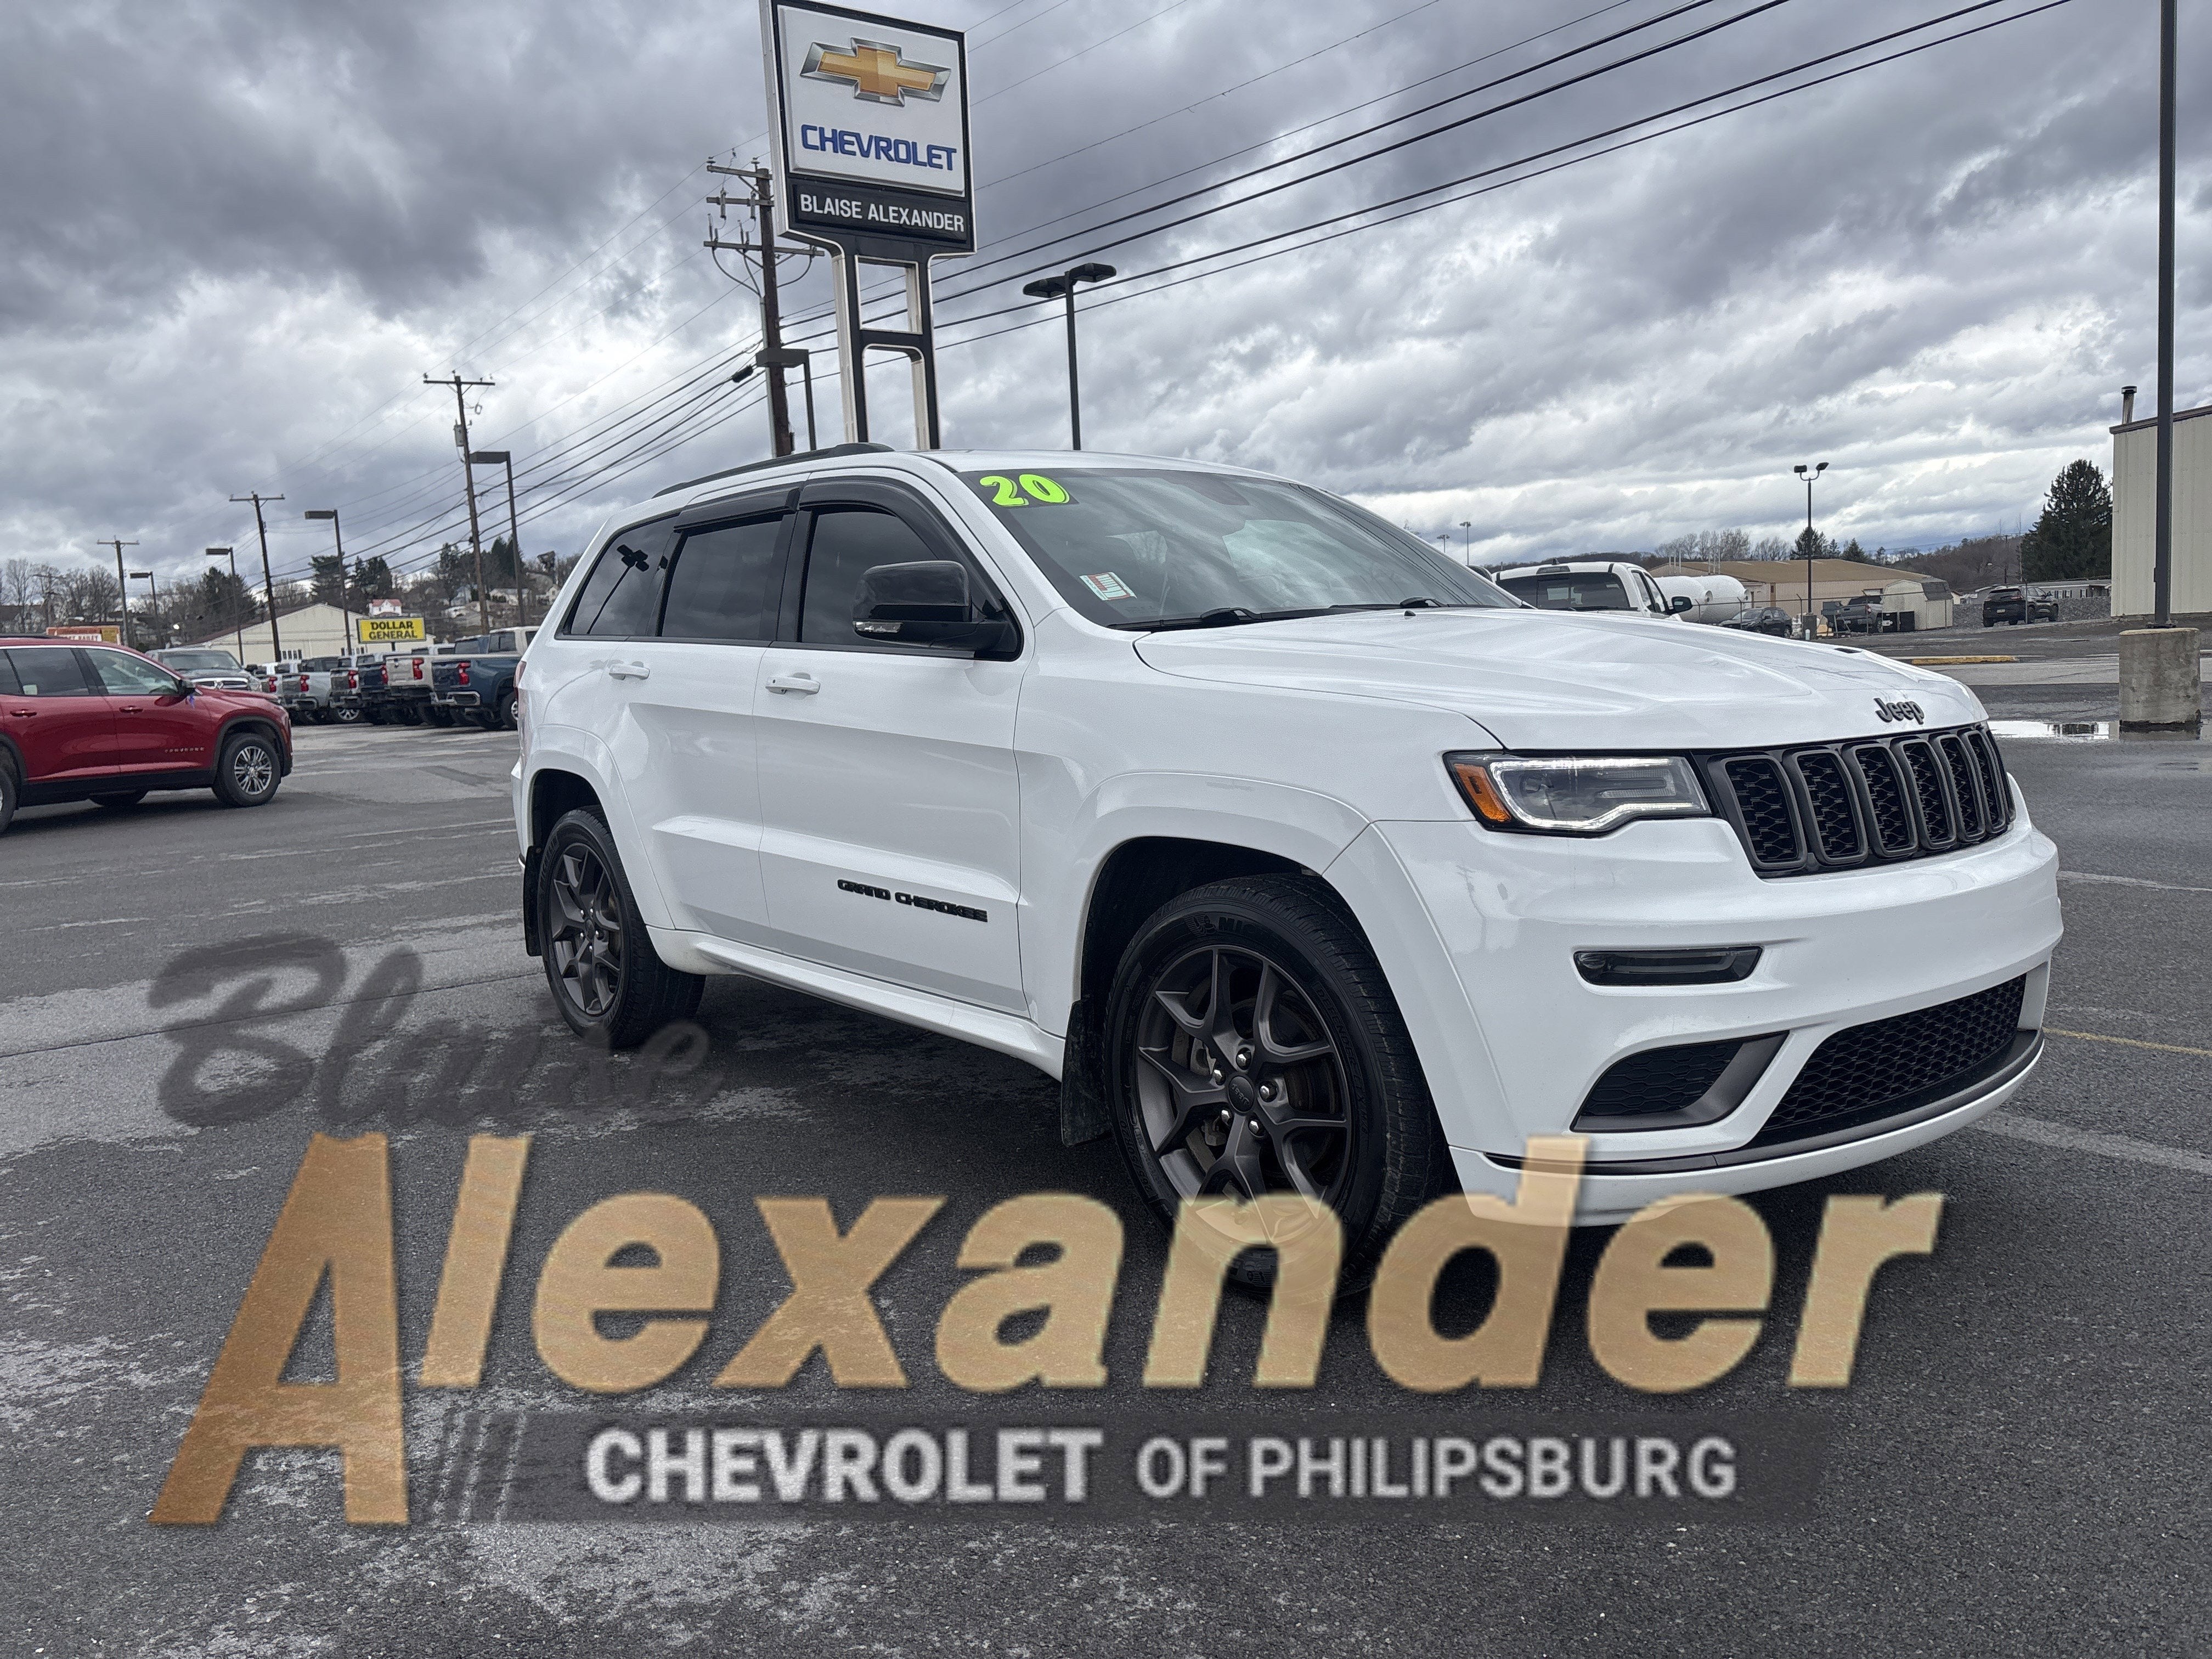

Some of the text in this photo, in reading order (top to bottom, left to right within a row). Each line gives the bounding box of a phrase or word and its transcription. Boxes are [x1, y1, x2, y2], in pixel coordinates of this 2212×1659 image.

[801, 124, 957, 171] CHEVROLET
[800, 193, 964, 233] BLAISE ALEXANDER
[979, 474, 1070, 506] 20
[369, 630, 417, 640] GENERAL
[370, 620, 414, 630] DOLLAR
[1874, 698, 1925, 725] Jeep
[837, 879, 988, 923] GRAND CHEROKEE
